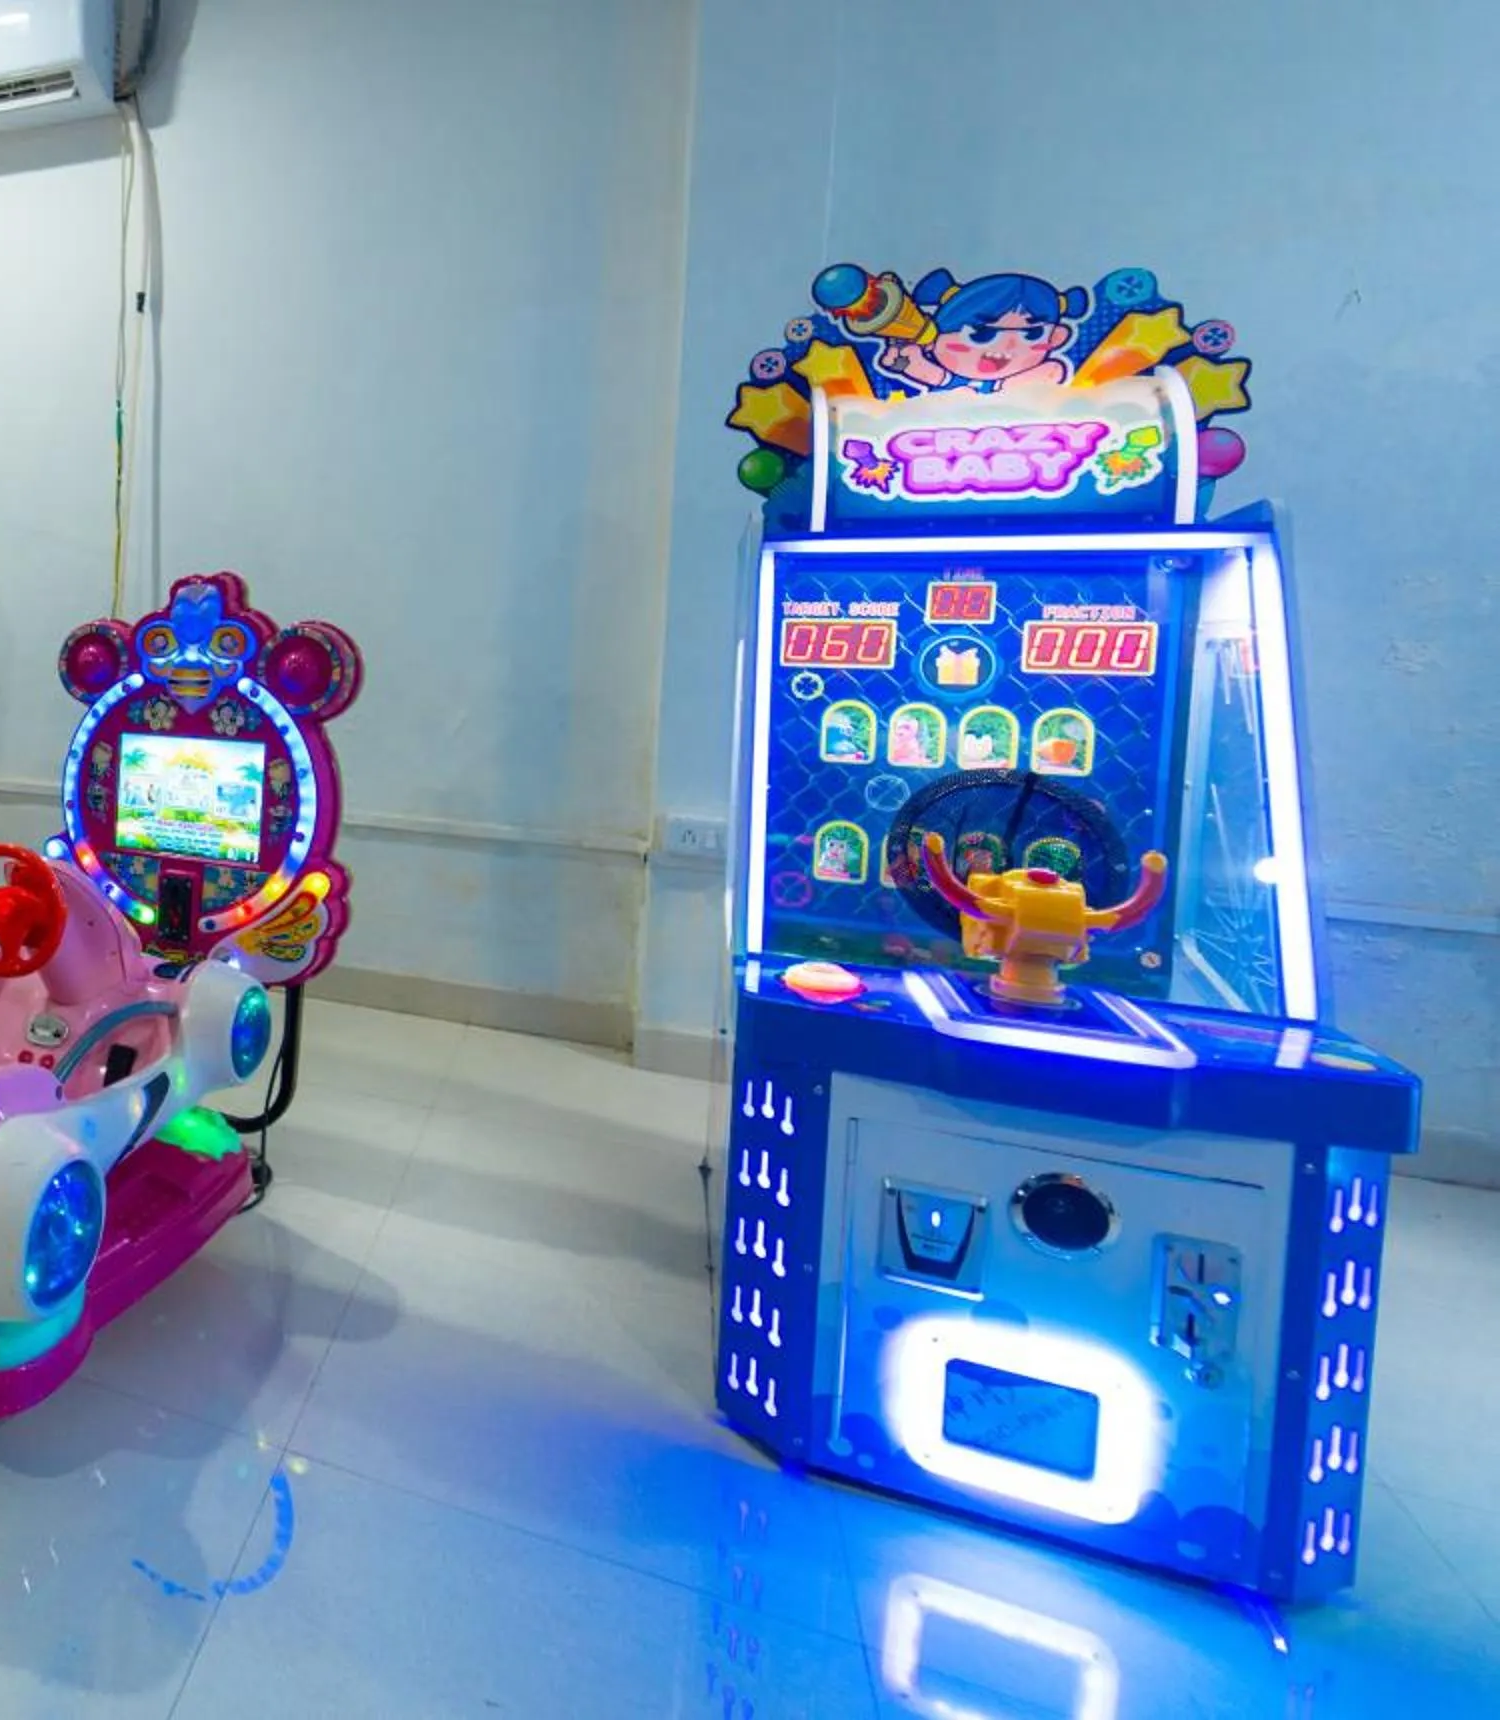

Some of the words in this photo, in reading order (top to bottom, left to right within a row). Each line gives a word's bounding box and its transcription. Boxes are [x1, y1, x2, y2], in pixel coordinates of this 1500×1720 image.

[891, 422, 1104, 454] CRAZY
[908, 451, 1073, 486] BABY
[781, 601, 841, 617] TARGET
[848, 601, 900, 617] SCORE
[932, 586, 991, 617] 00
[1042, 604, 1137, 621] FRACTION
[786, 624, 892, 662] 060
[1027, 627, 1150, 669] 000
